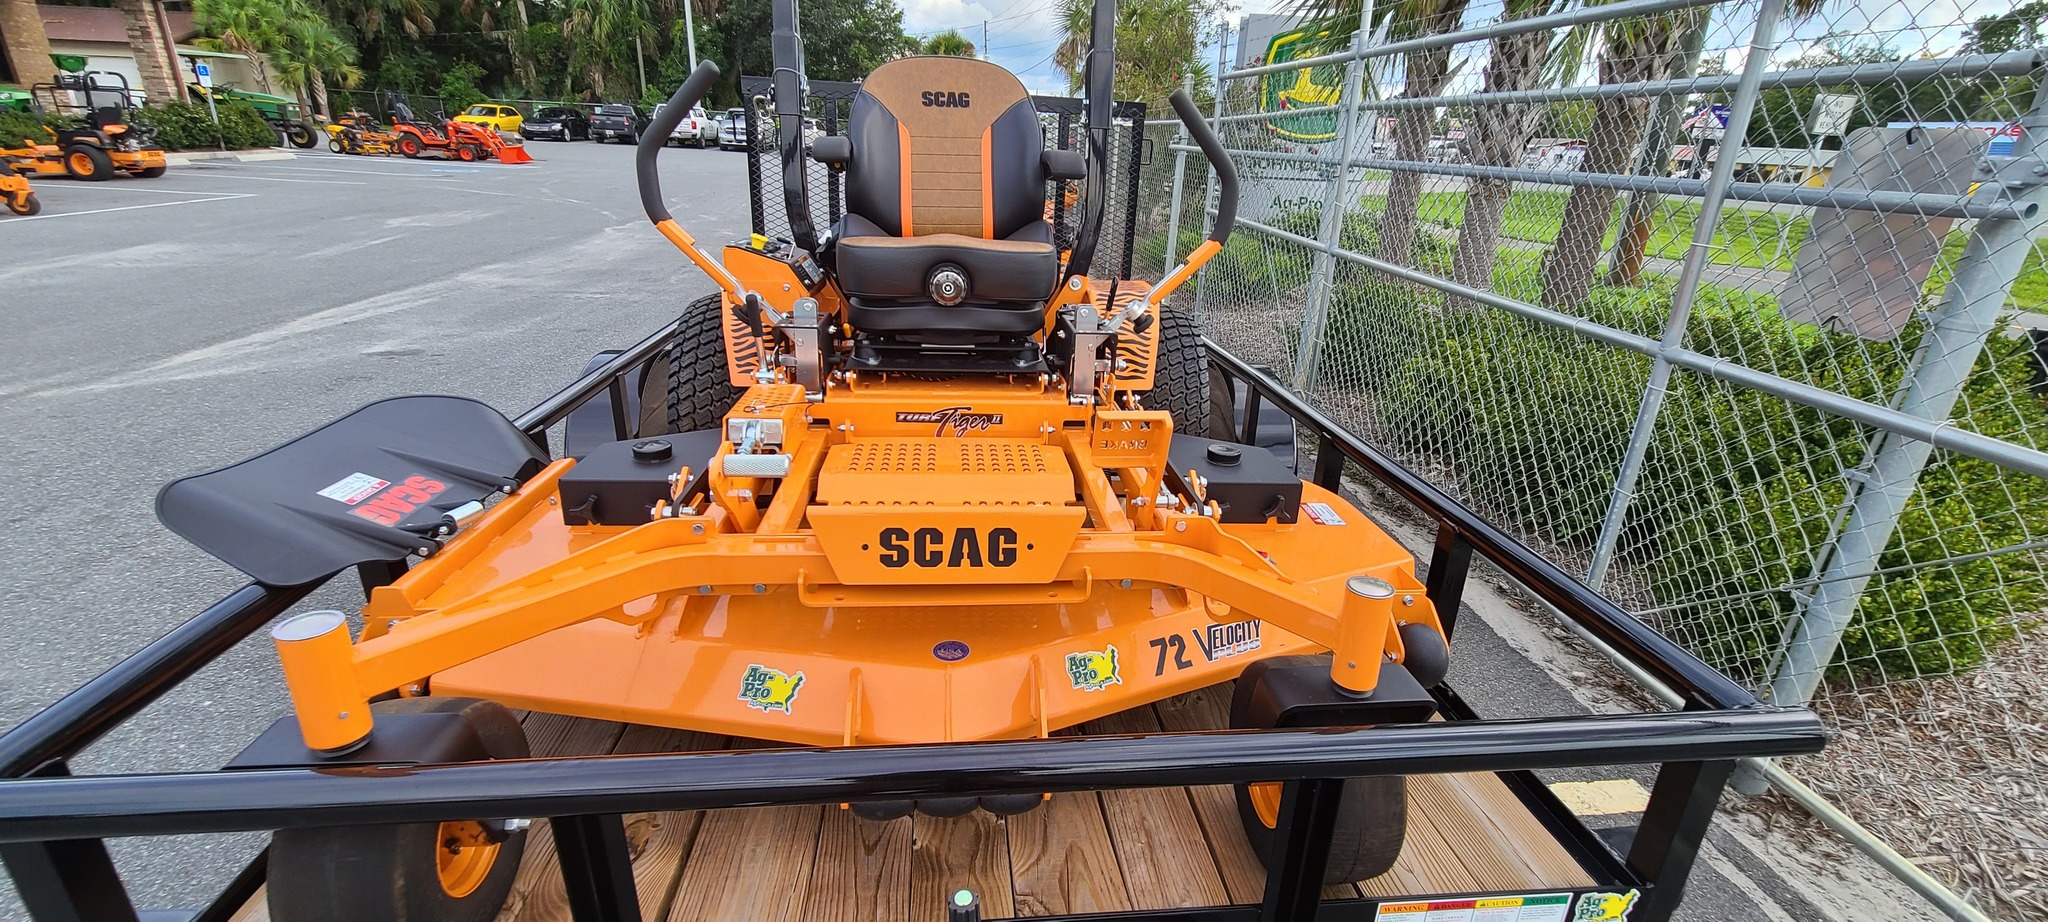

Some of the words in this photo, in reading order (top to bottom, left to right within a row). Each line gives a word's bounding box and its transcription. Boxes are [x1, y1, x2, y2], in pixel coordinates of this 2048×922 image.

[921, 90, 970, 108] SCAG
[896, 412, 943, 423] TURF
[931, 406, 991, 438] Tiger
[355, 475, 446, 525] SCAG
[879, 527, 1018, 568] SCAG
[1148, 633, 1194, 677] 72
[1191, 619, 1261, 662] VELOCITY
[1213, 638, 1261, 661] PLUS
[1069, 656, 1092, 671] Ag-
[744, 667, 774, 687] Ag-
[1071, 669, 1098, 686] Pro
[740, 682, 771, 699] Pro
[1383, 904, 1425, 913] WARNING
[1439, 901, 1473, 910] DANGER
[1486, 898, 1520, 908] CAUTION
[1531, 896, 1561, 904] NOTICE
[1580, 896, 1608, 909] Ag-
[1579, 907, 1606, 920] Pro
